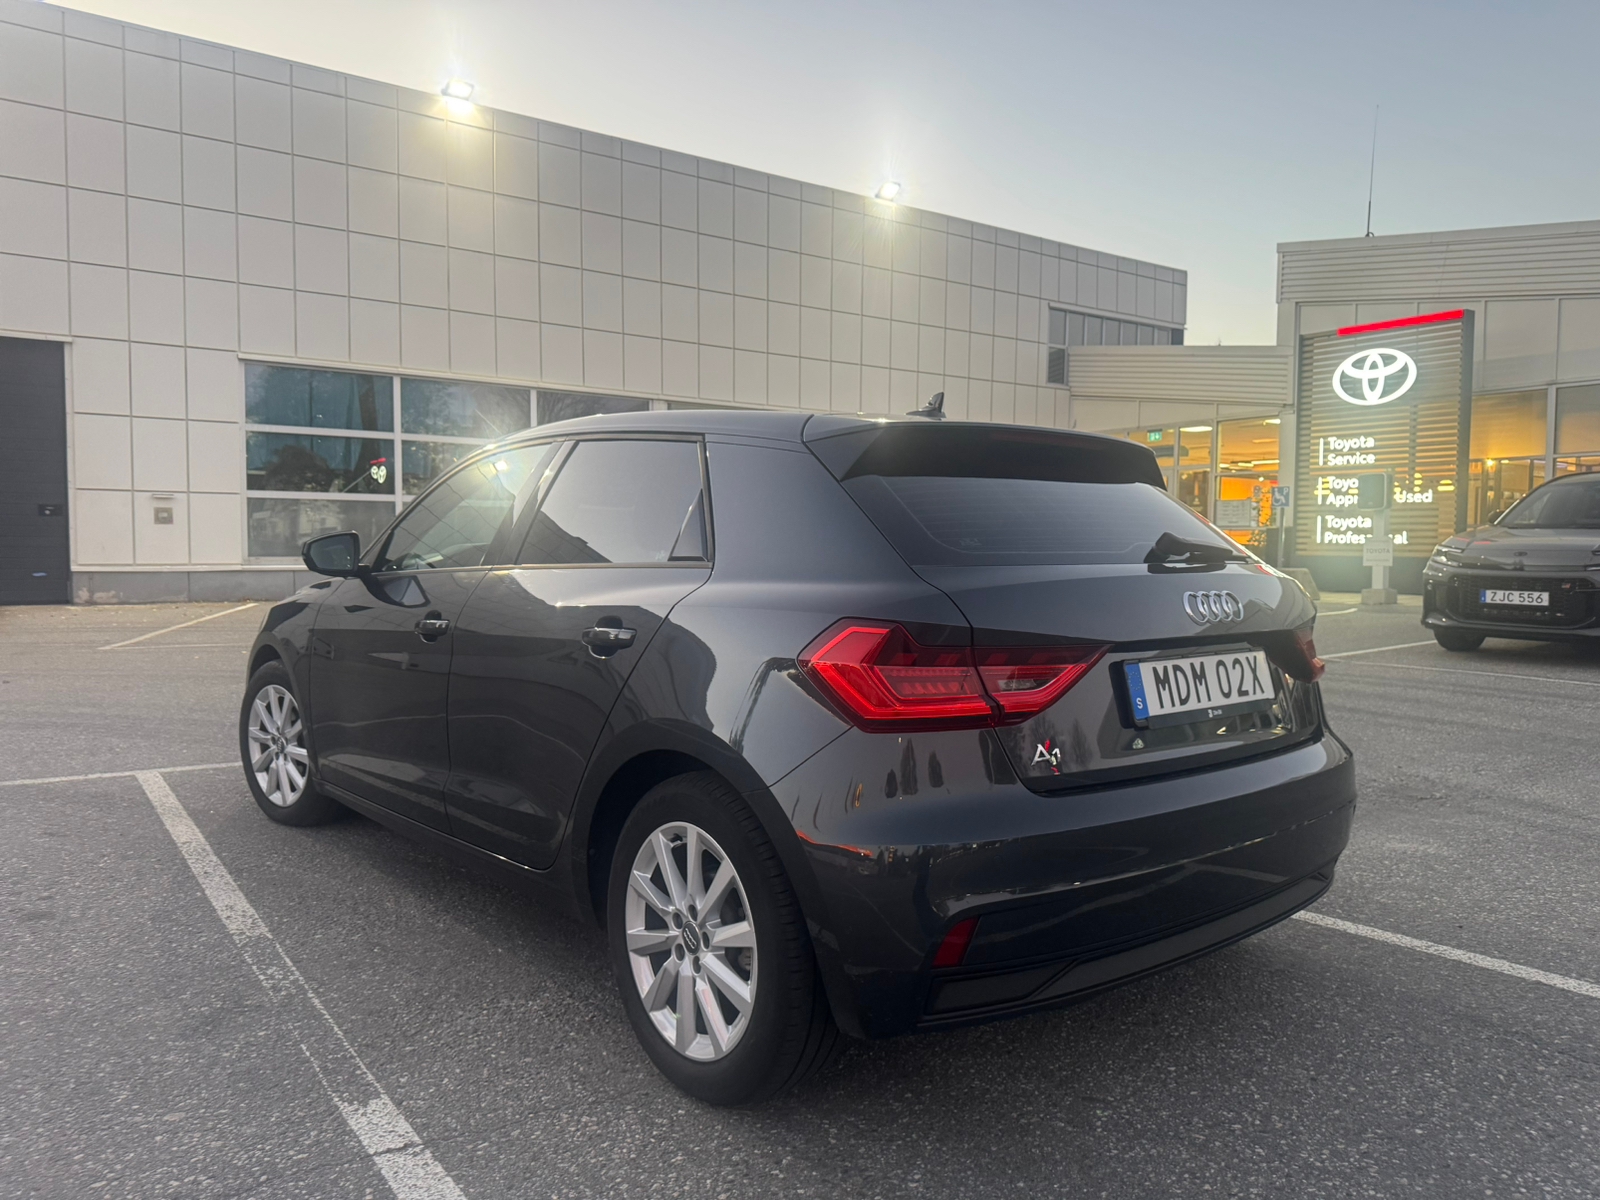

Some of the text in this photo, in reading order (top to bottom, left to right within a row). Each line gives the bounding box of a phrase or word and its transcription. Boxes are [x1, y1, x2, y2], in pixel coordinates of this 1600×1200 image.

[1327, 435, 1375, 452] Toyota
[1327, 451, 1376, 466] Service
[1283, 487, 1289, 496] P
[1326, 476, 1359, 492] Toyo
[1395, 488, 1433, 503] Used
[1325, 515, 1372, 531] Toyota
[1490, 591, 1514, 603] ZJC
[1518, 592, 1544, 604] 556
[1152, 655, 1265, 709] MDM 02X
[1136, 697, 1144, 710] S
[1031, 743, 1061, 767] A1
